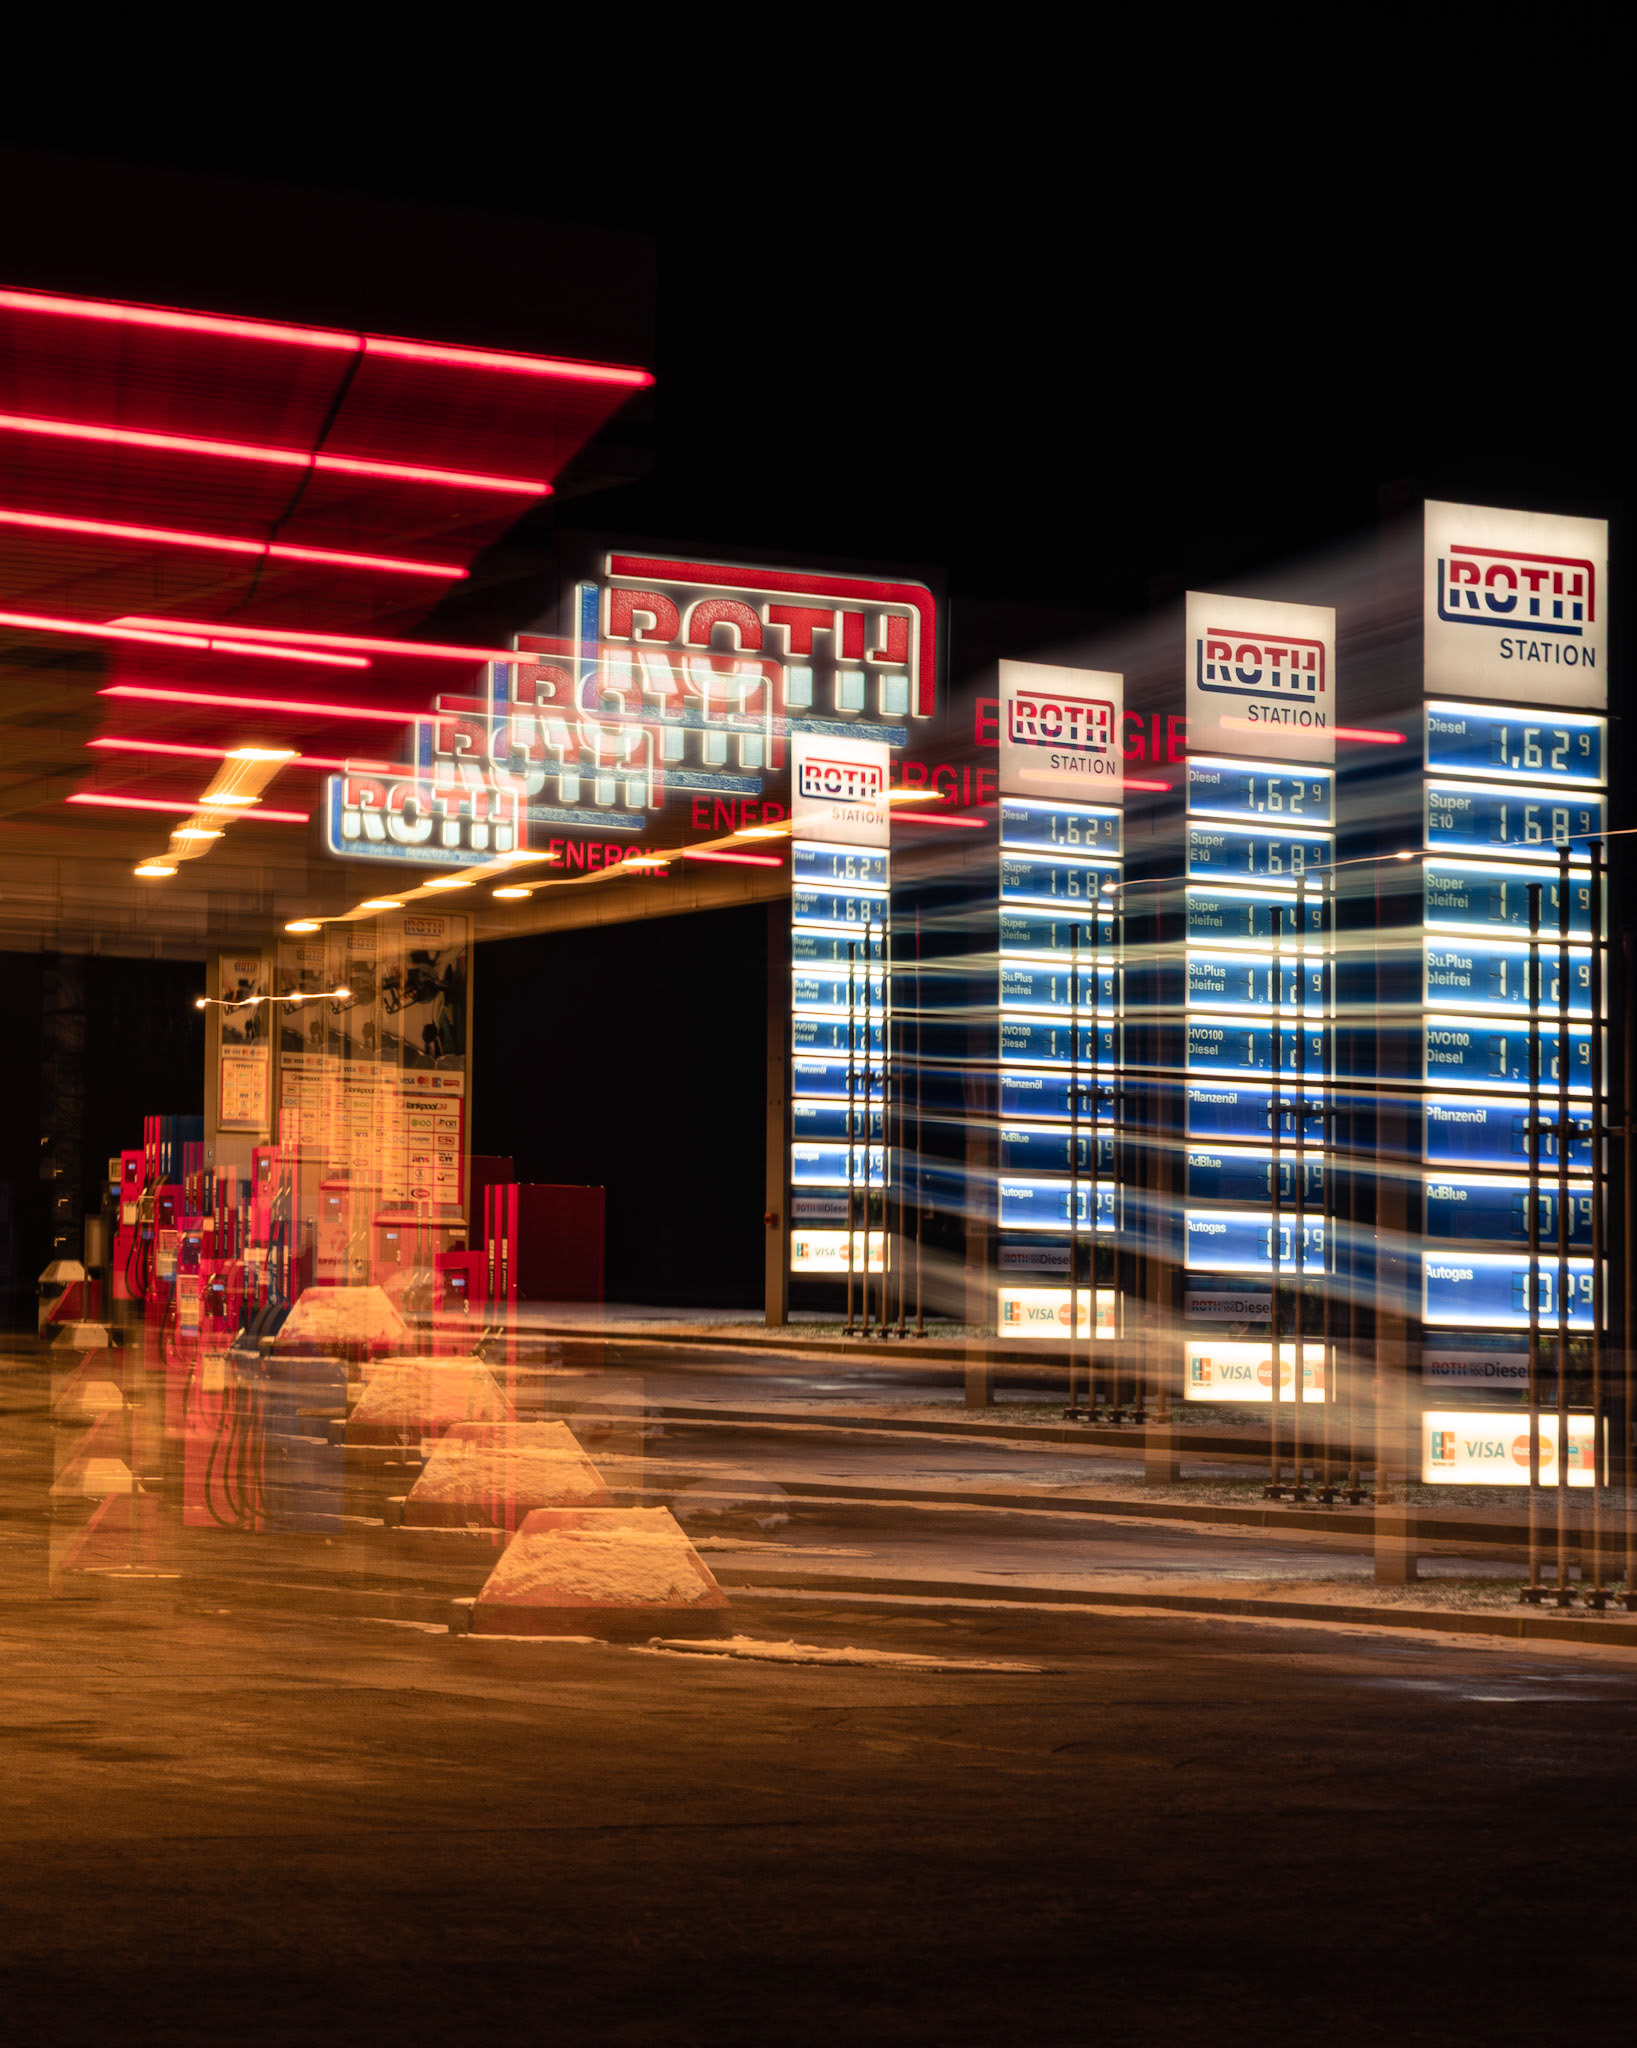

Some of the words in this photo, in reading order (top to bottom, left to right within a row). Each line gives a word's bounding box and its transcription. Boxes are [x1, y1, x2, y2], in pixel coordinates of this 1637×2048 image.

[1450, 559, 1583, 622] ROTH
[602, 585, 910, 716] ROTH
[1500, 637, 1596, 668] STATION
[1206, 640, 1316, 691] ROTH
[1016, 700, 1107, 743] ROTH
[1248, 704, 1326, 728] STATION
[1427, 718, 1466, 735] Diesel
[1050, 754, 1116, 776] STATION
[805, 765, 877, 798] ROTH
[1189, 770, 1221, 784] Diesel
[1429, 793, 1471, 813] Super
[343, 778, 516, 851] ROTH
[832, 807, 884, 825] STATION
[1001, 809, 1028, 821] Diesel
[1428, 813, 1454, 829] E10
[1190, 832, 1225, 848] Super
[1190, 849, 1211, 863] E10
[1003, 861, 1032, 875] Super
[1002, 875, 1020, 886] E10
[1425, 873, 1464, 892] Super
[1188, 898, 1220, 914] Super
[1425, 892, 1469, 909] bleifrei
[1001, 917, 1028, 929] Super
[1188, 914, 1223, 928] bleifrei
[1427, 953, 1473, 970] Su.Plus
[1188, 963, 1226, 978] Su.Plus
[1427, 970, 1471, 987] bleifrei
[1001, 985, 1032, 995] bleifrei
[1188, 978, 1225, 992] bleifrei
[1188, 1028, 1224, 1041] HVO100
[1426, 1031, 1470, 1047] HVO100
[1188, 1043, 1219, 1056] Diesel
[1426, 1049, 1464, 1065] Diesel
[1187, 1089, 1238, 1105] Pflanzenöl
[1425, 1106, 1487, 1124] Pflanzenöl
[1187, 1155, 1223, 1169] AdBlue
[1426, 1185, 1468, 1201] AdBlue
[1187, 1220, 1227, 1236] Autogas
[1425, 1264, 1474, 1283] Autogas
[1026, 1307, 1055, 1320] VISA
[1191, 1300, 1221, 1312] ROTH
[1218, 1365, 1253, 1380] VISA
[1431, 1361, 1467, 1376] ROTH
[1464, 1440, 1505, 1459] VISA
